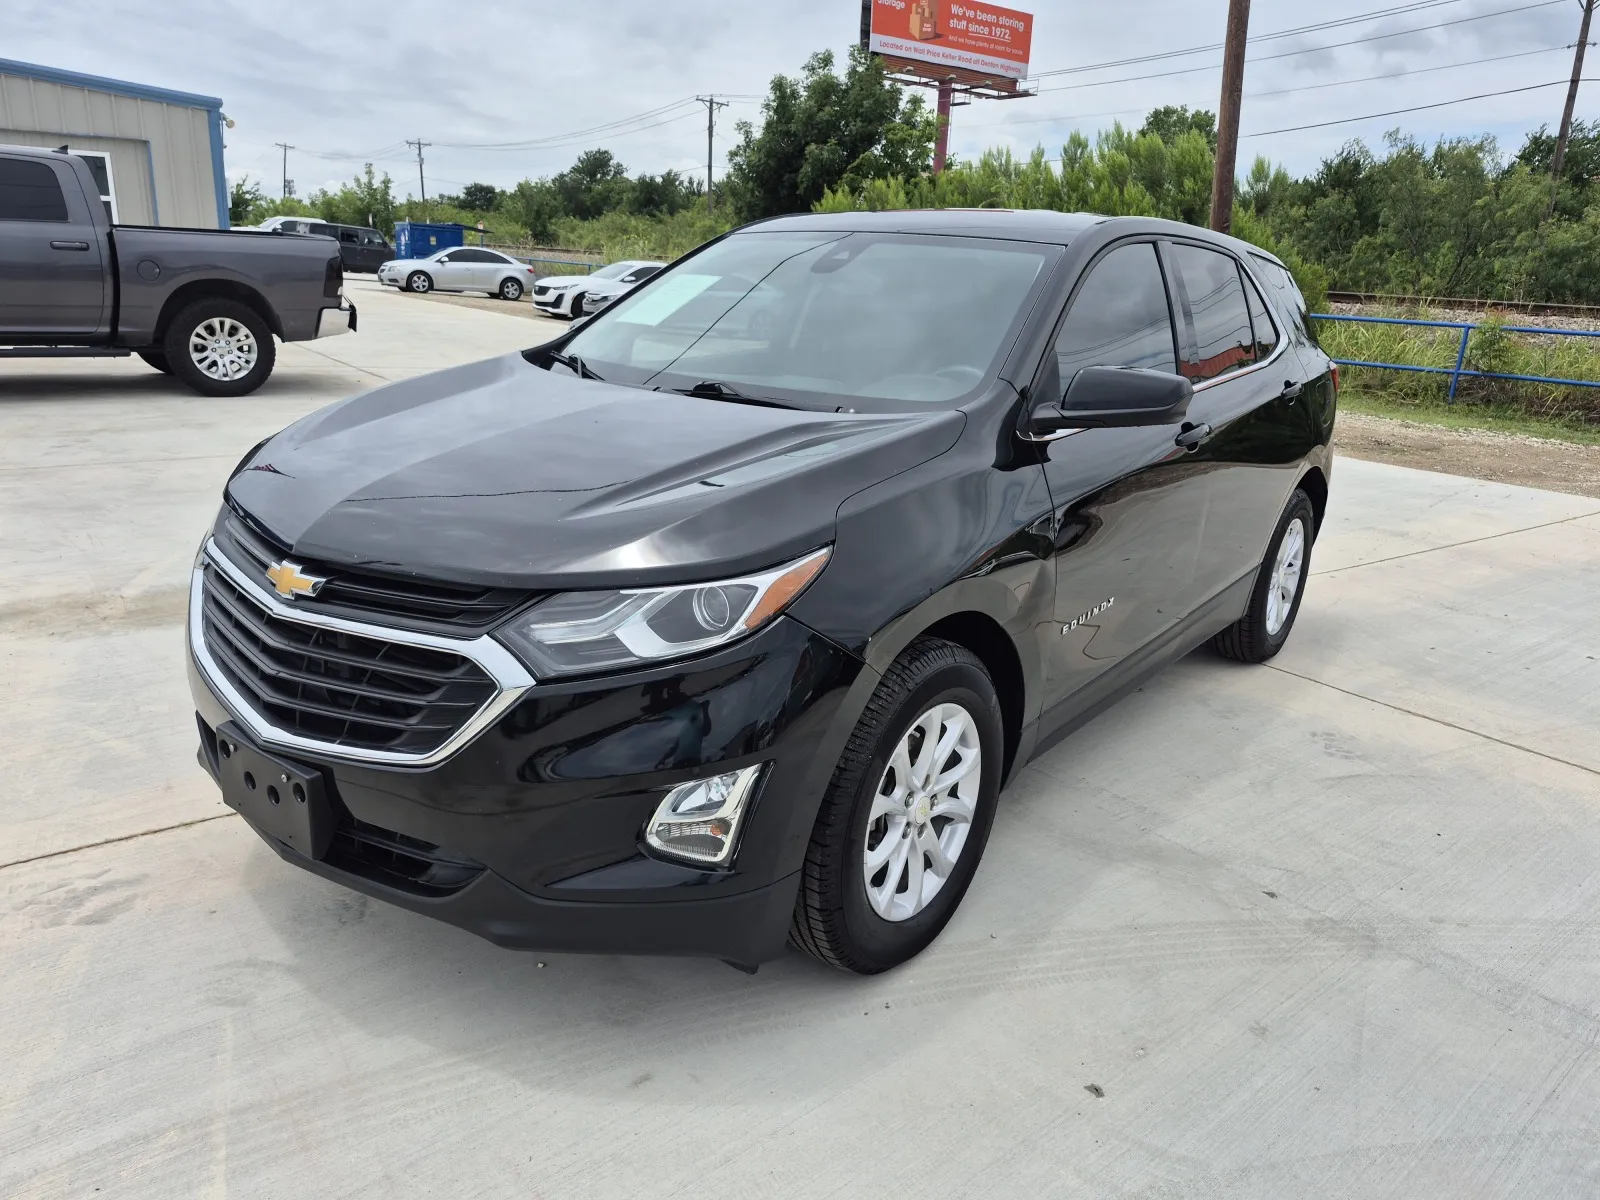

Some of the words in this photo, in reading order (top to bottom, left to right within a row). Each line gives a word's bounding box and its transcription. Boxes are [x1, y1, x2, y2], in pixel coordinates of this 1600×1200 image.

[949, 18, 967, 30] stuff
[968, 23, 989, 34] since
[991, 26, 1011, 40] 1972.
[951, 4, 975, 18] We've
[976, 10, 997, 23] been
[999, 16, 1024, 32] storing
[880, 40, 903, 51] Located
[927, 49, 940, 58] Price
[942, 52, 957, 60] Keller
[958, 55, 972, 64] Road
[981, 60, 999, 69] Denton
[1061, 597, 1114, 635] EQUINOX
